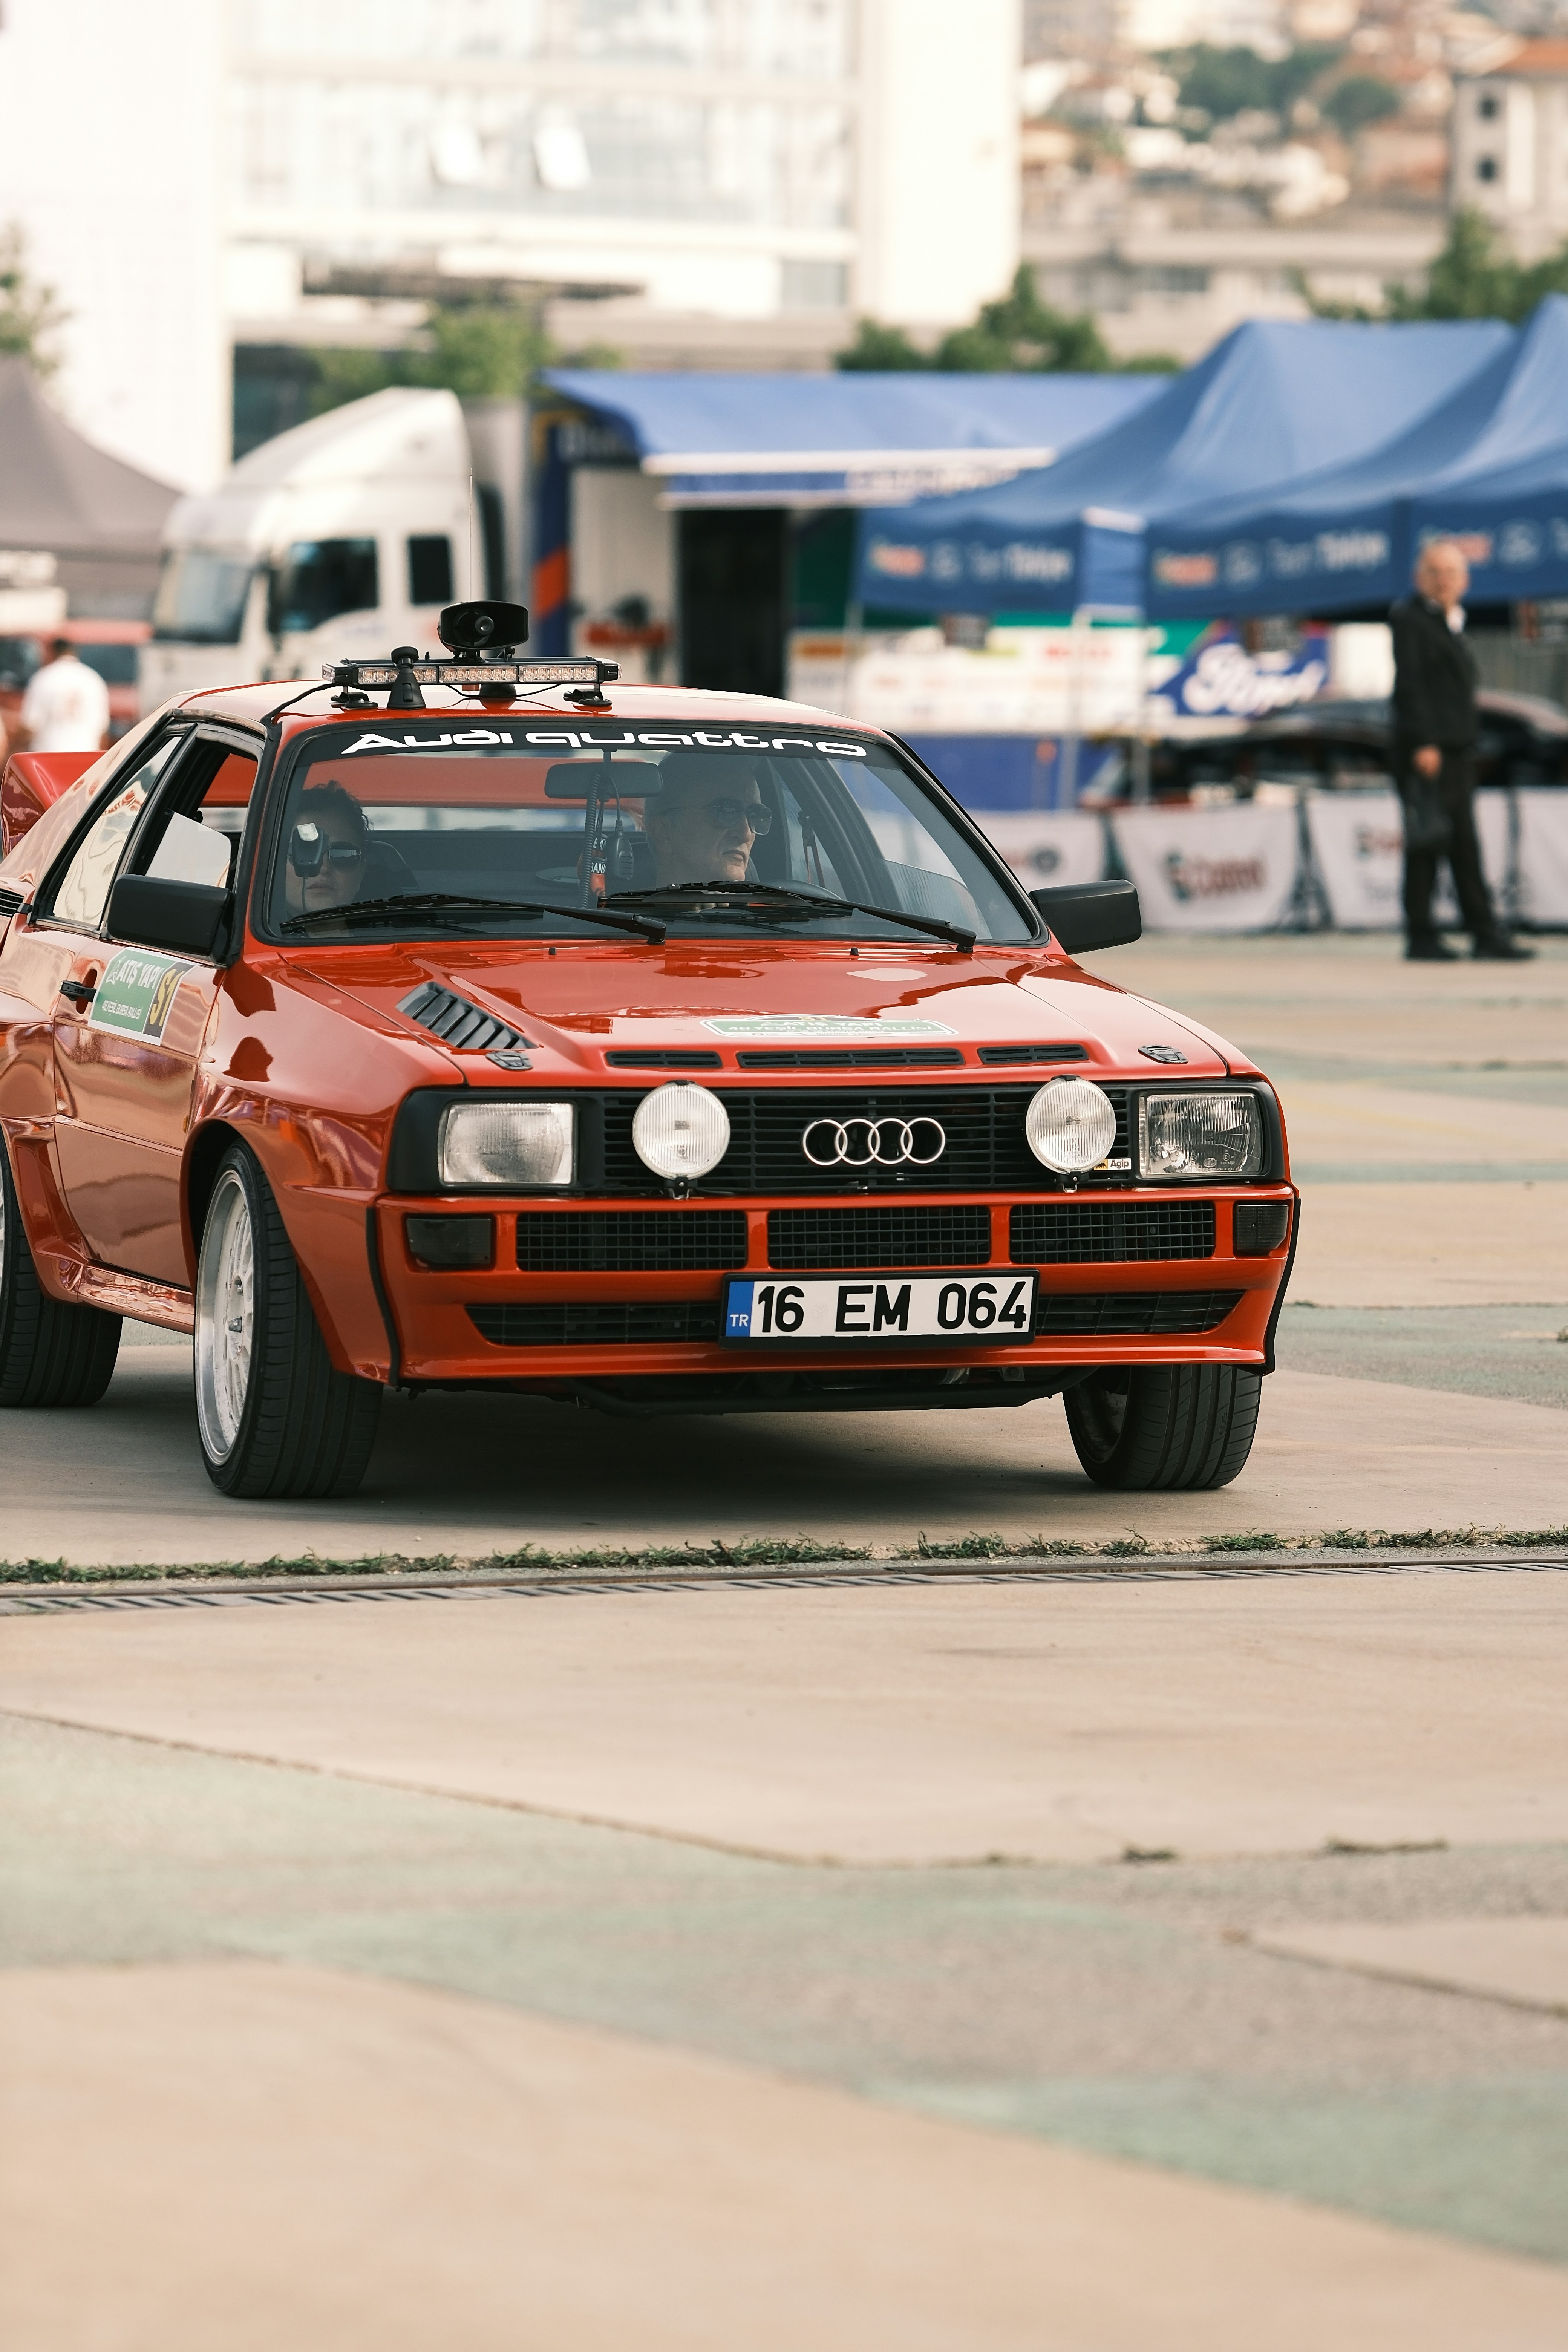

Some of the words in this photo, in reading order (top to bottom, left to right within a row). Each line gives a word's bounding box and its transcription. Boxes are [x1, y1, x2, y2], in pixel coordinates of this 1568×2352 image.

[340, 729, 514, 755] Audi
[525, 730, 868, 757] quattro
[137, 963, 165, 989] YAPI
[149, 969, 185, 1026] S1
[1110, 1159, 1129, 1169] Agip
[730, 1314, 749, 1327] TR
[758, 1286, 805, 1333] 16
[835, 1284, 911, 1332] EM
[937, 1281, 1027, 1330] 064
